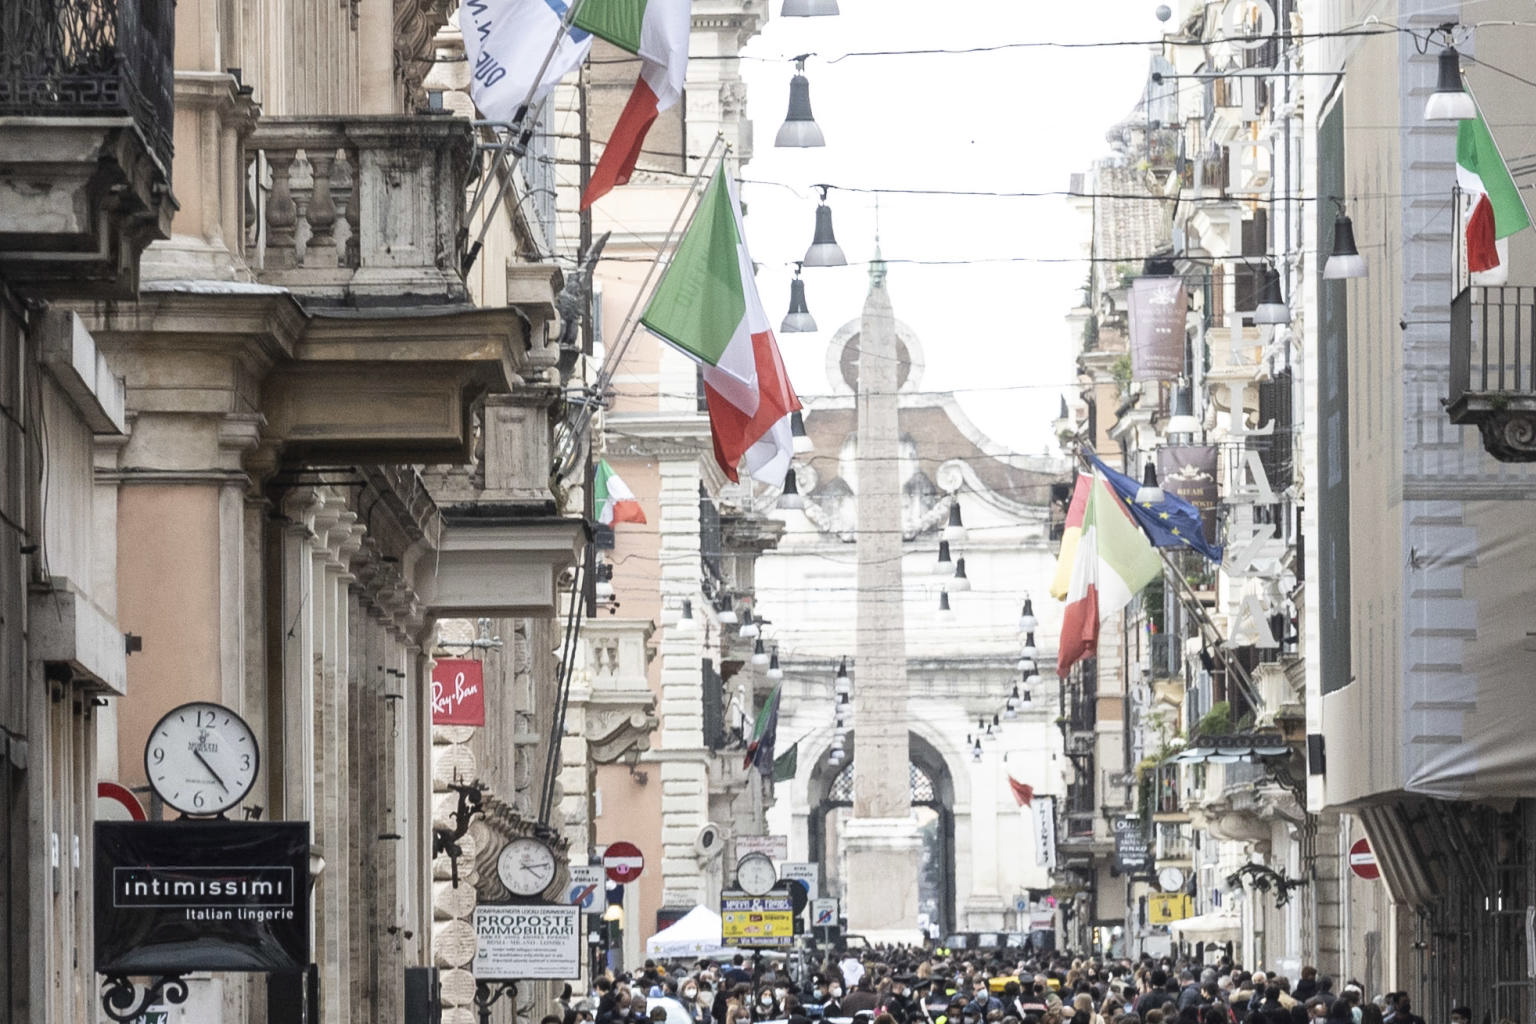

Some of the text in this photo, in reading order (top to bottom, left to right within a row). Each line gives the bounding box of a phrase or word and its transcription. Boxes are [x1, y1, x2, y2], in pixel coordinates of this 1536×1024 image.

[197, 711, 216, 728] 12
[154, 748, 165, 765] 9
[240, 754, 250, 771] 3
[193, 790, 204, 808] 6
[125, 877, 283, 895] intimissimi
[186, 908, 294, 922] Italian lingerie
[476, 915, 574, 926] PROPOSTE
[476, 926, 574, 935] IMMOBILIARI
